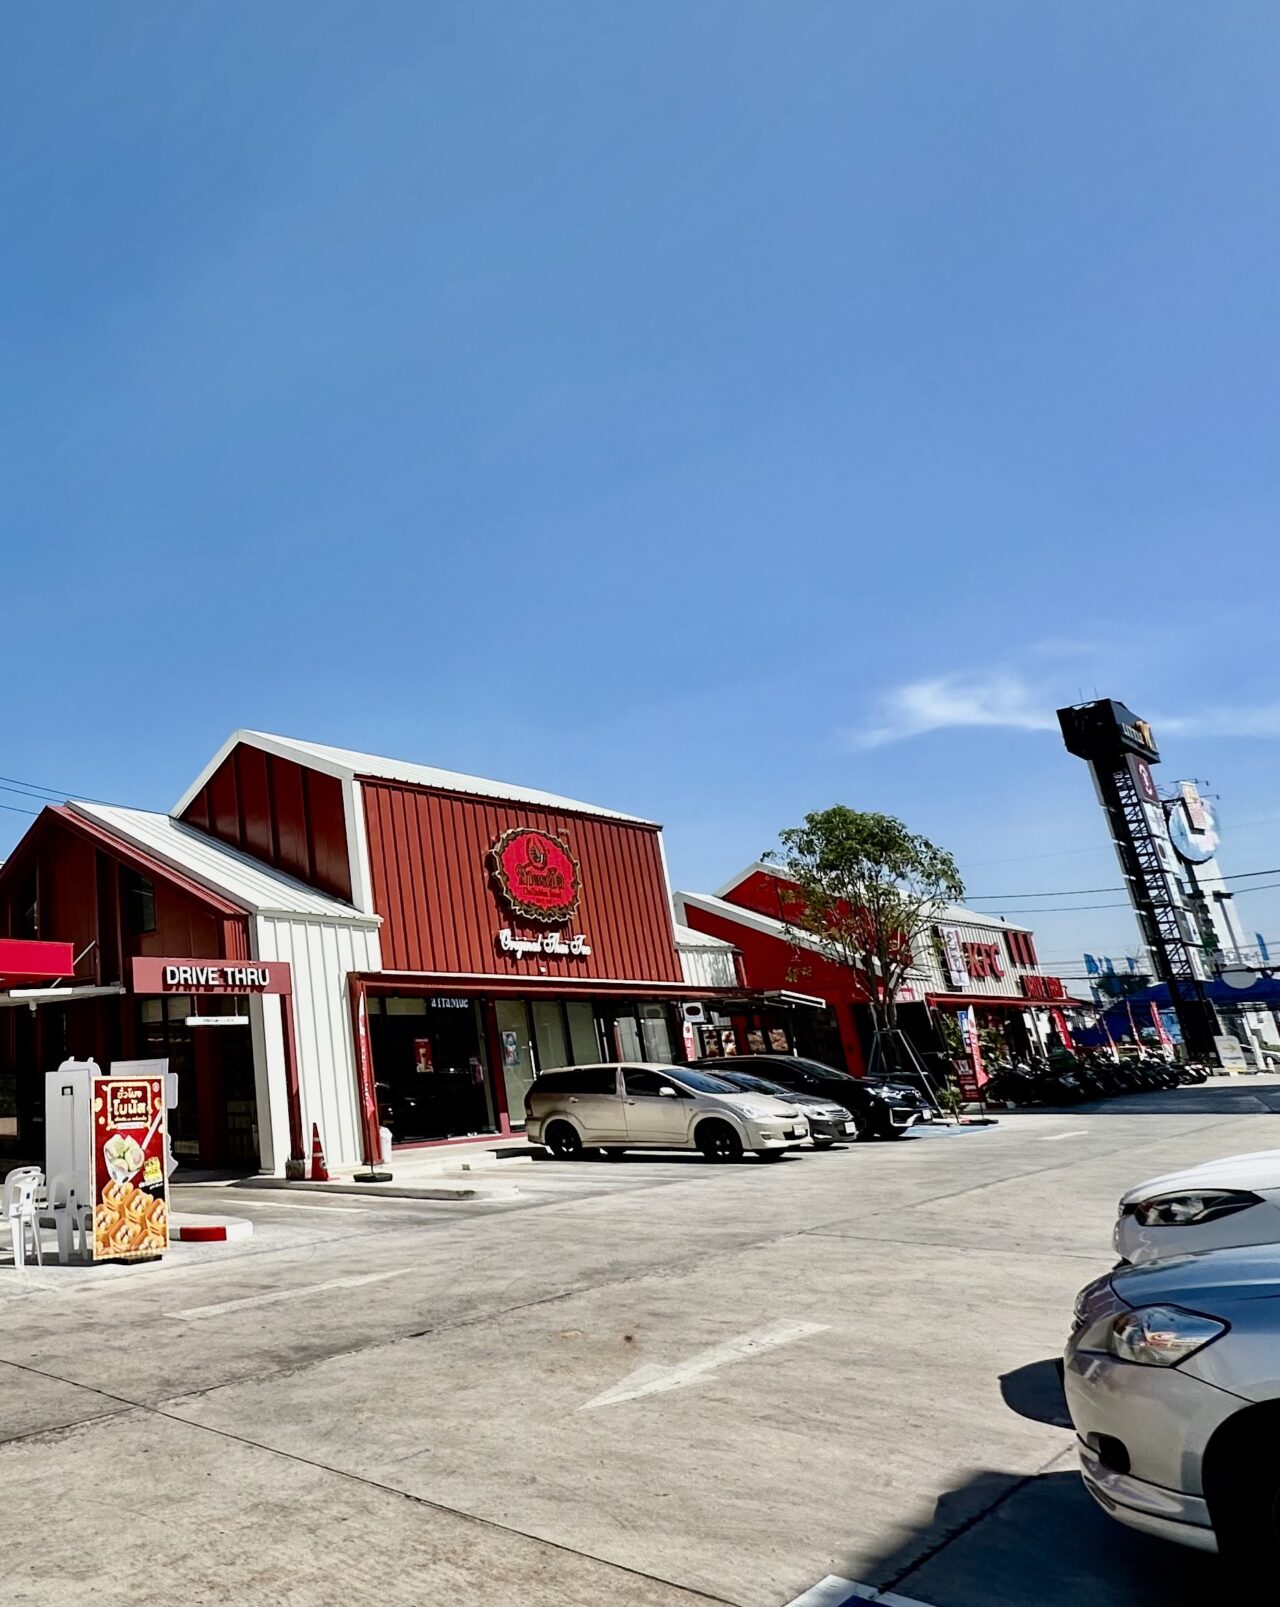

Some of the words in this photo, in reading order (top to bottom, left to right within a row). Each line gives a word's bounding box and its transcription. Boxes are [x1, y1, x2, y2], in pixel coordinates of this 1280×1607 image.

[499, 928, 543, 960] Original
[543, 932, 569, 955] Thai
[964, 942, 1004, 978] KFC
[166, 966, 219, 985] DRIVE
[224, 967, 270, 986] THRU
[112, 1098, 147, 1116] โบนัส
